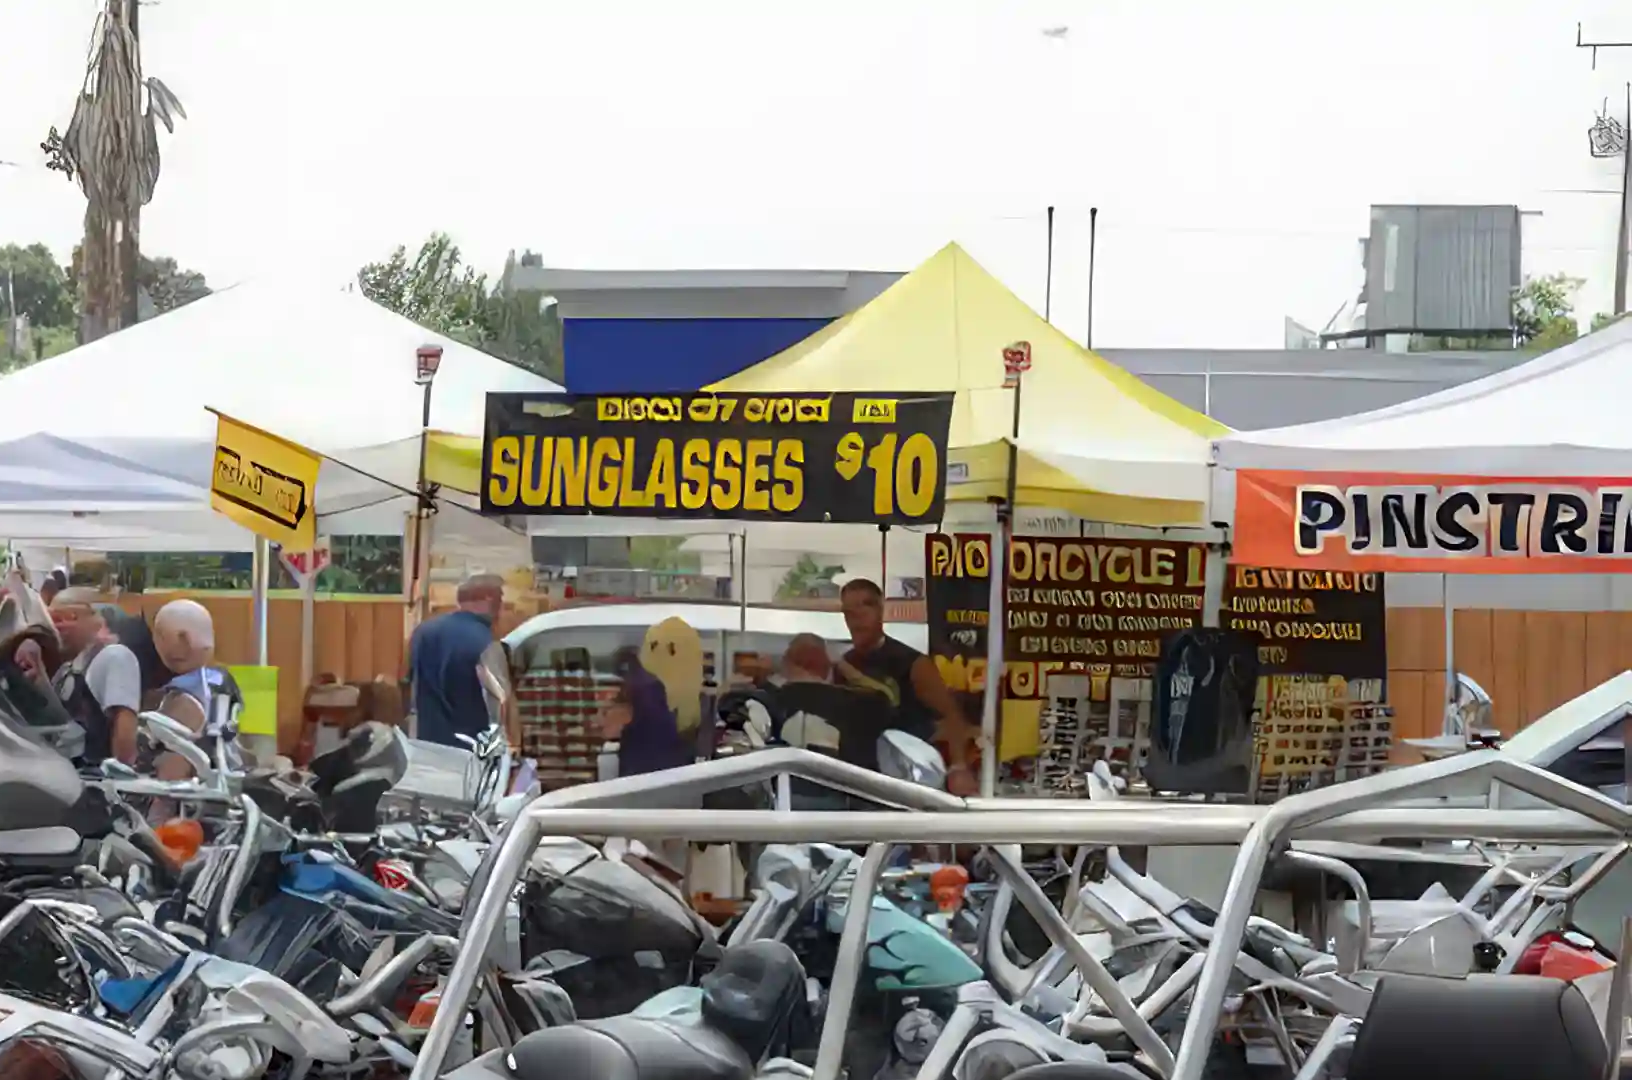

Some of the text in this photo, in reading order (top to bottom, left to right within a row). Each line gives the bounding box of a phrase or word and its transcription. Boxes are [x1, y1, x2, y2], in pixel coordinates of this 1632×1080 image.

[489, 430, 938, 518] SUNGLASSES $10
[1298, 490, 1632, 555] PINSTRI
[931, 538, 1175, 586] MOORCYCLE
